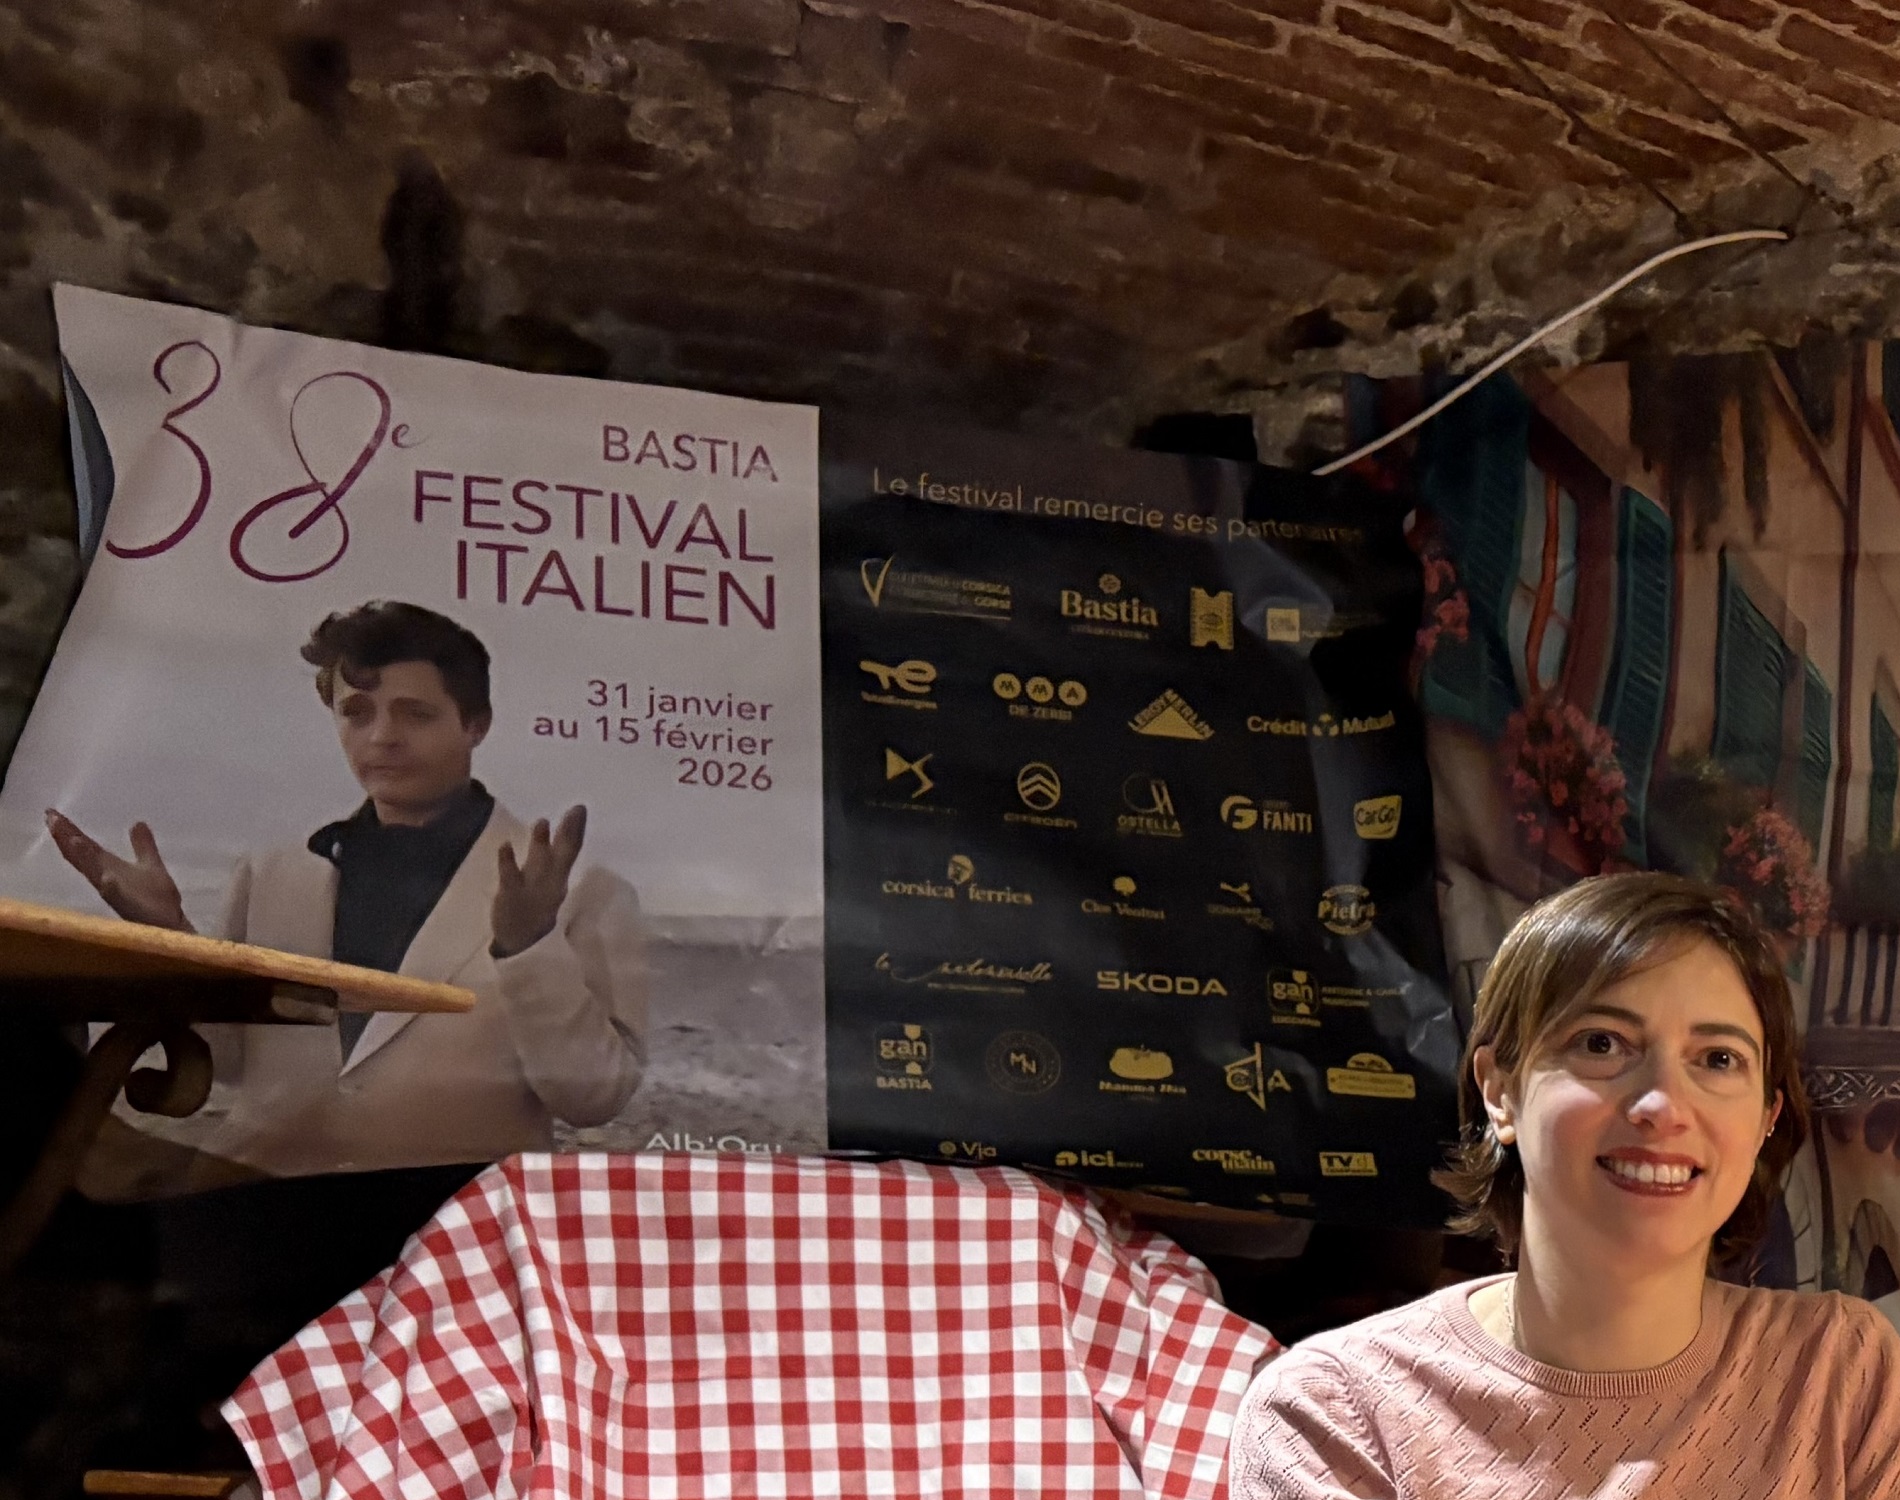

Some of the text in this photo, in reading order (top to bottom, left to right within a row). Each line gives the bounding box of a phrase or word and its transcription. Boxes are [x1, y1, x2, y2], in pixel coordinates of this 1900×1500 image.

[601, 425, 779, 483] BASTIA
[412, 471, 774, 562] FESTIVAL
[873, 467, 909, 496] Le
[919, 472, 1022, 512] festival
[1034, 496, 1164, 529] remercie
[1172, 511, 1219, 535] ses
[455, 541, 777, 630] ITALIEN
[1060, 588, 1161, 628] Bastia
[585, 678, 773, 724] 31 janvier
[533, 714, 774, 757] au 15 février
[677, 756, 774, 792] 2026
[1262, 811, 1314, 835] FANTI
[882, 879, 955, 900] corsica
[1272, 981, 1314, 1004] gan
[879, 1038, 927, 1060] gan
[876, 1076, 932, 1090] BASTIA
